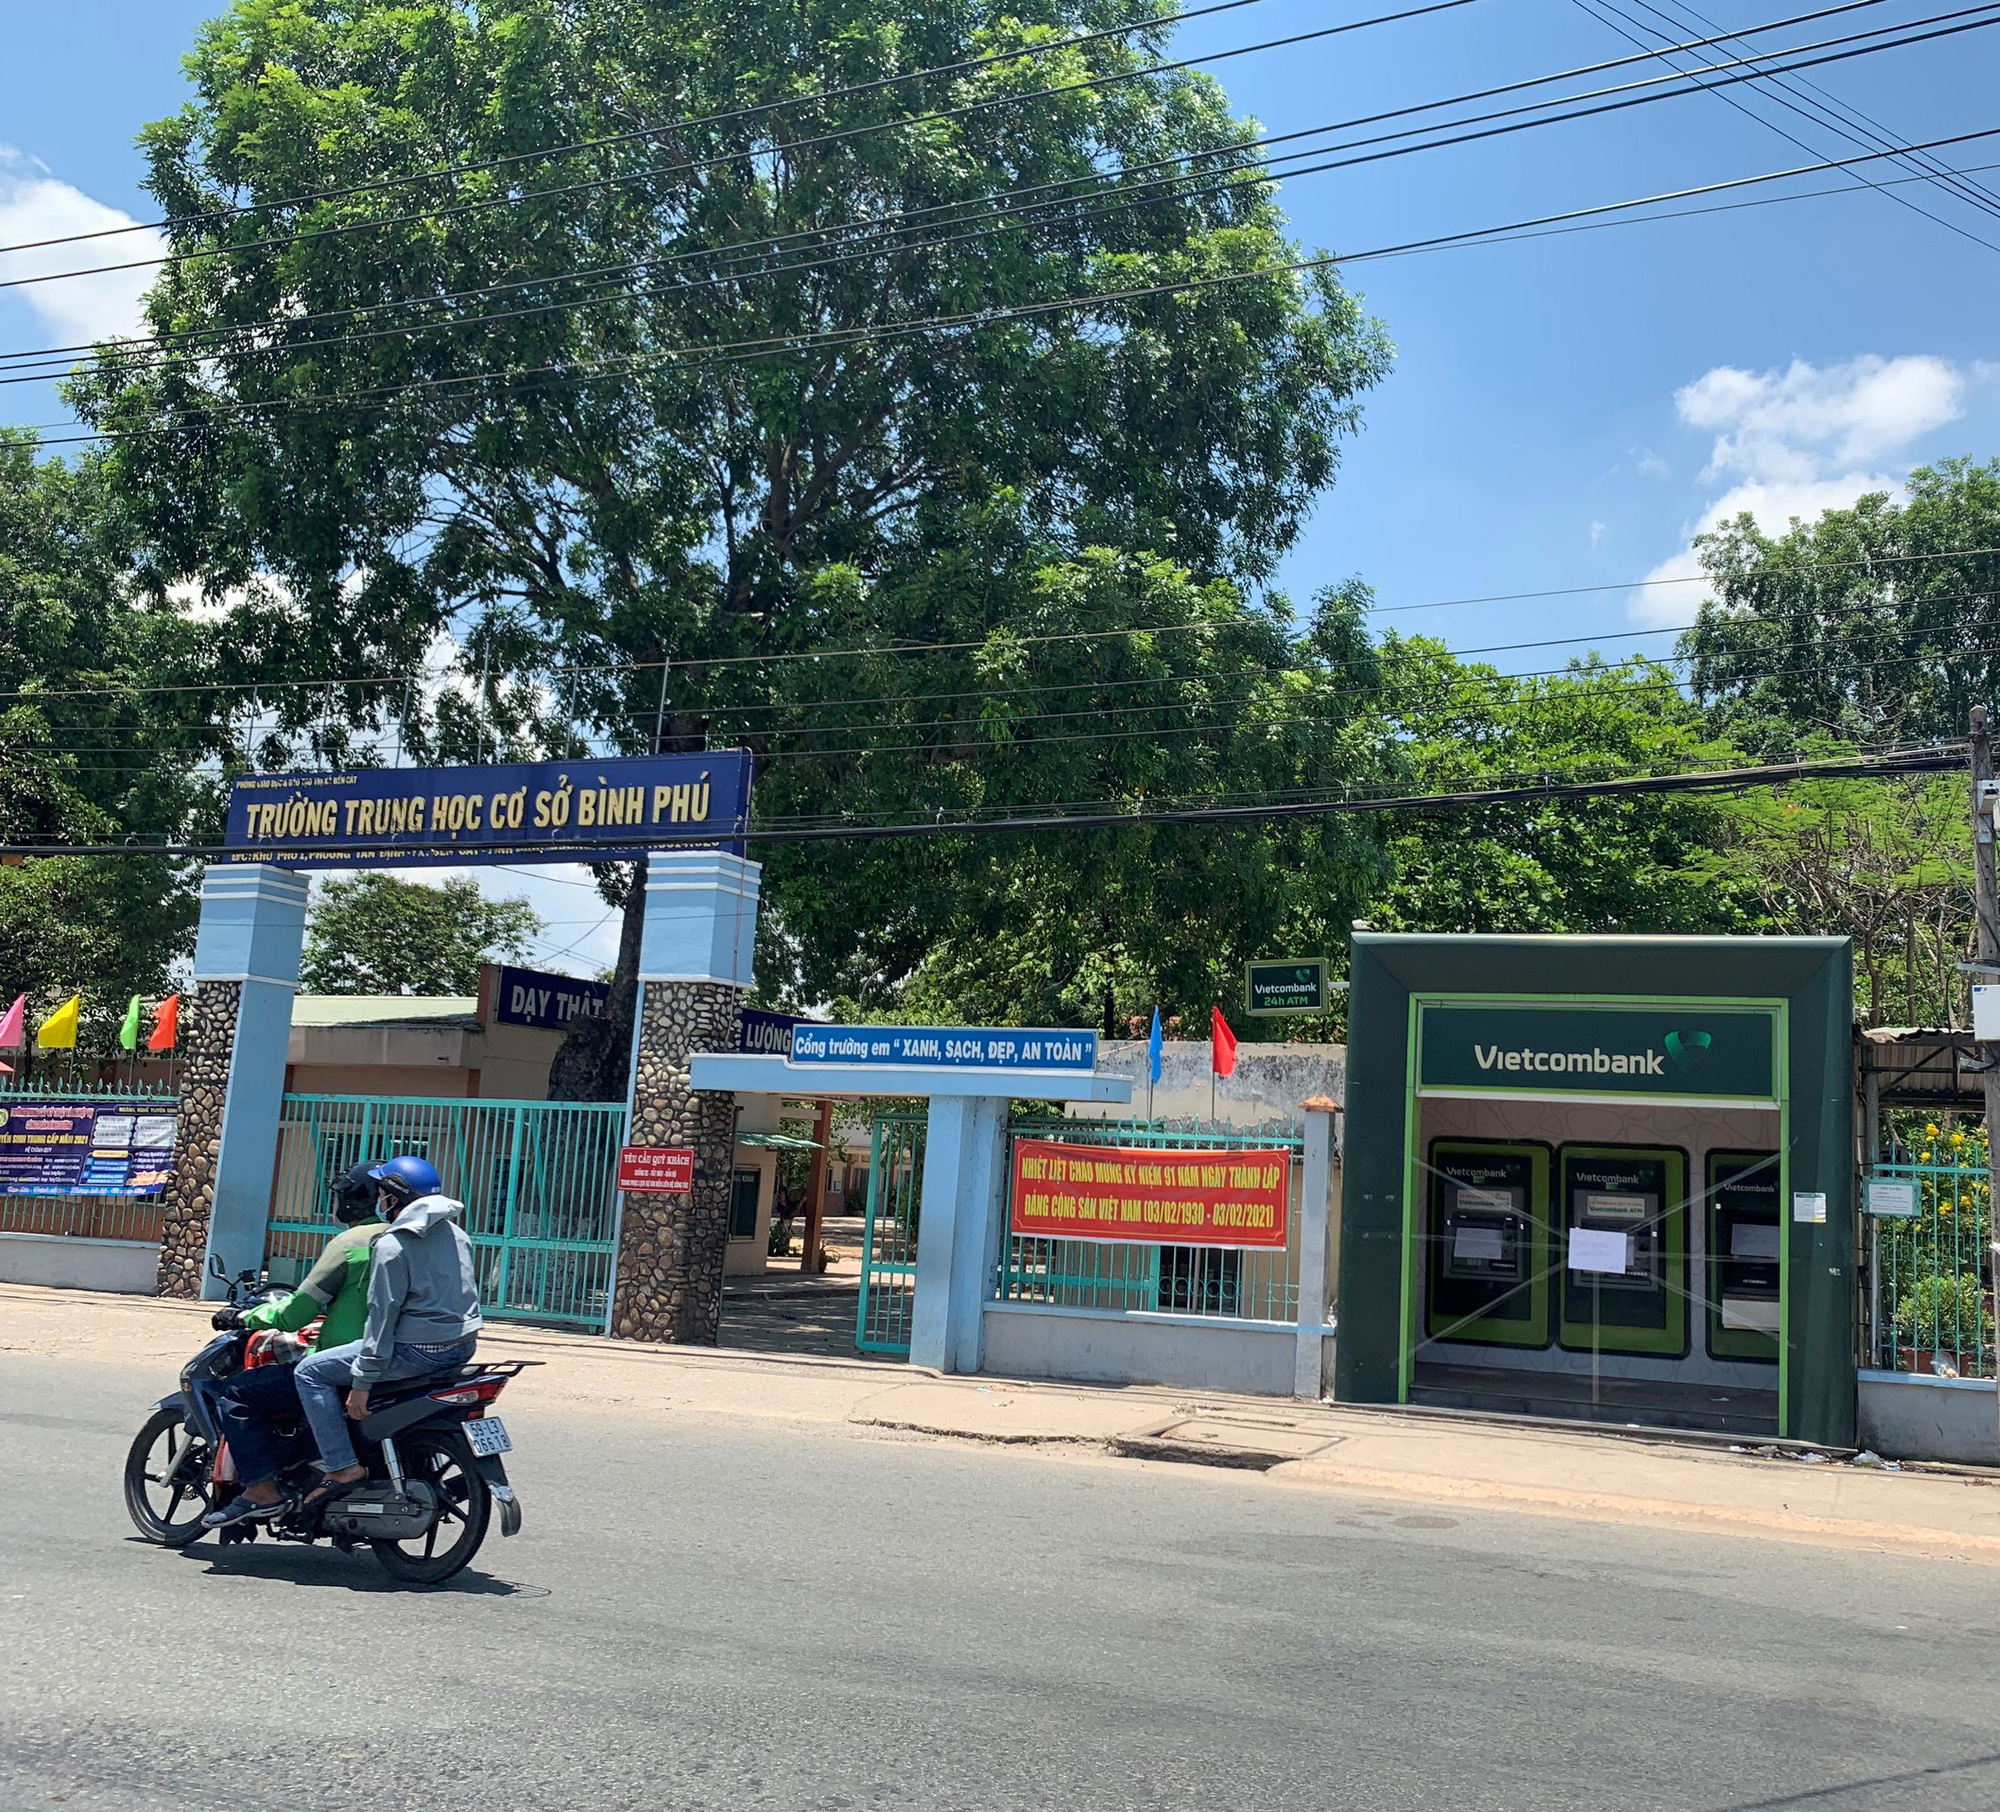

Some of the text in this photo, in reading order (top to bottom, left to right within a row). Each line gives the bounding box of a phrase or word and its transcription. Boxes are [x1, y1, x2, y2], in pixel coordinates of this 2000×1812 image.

[246, 771, 710, 840] TRƯỜNG TRUNG HỌC CƠ SỞ BÌNH PHÚ
[1254, 982, 1317, 994] Vietcombank
[511, 985, 551, 1023] DẠY
[1264, 996, 1308, 1006] 24h ATM
[745, 1021, 792, 1054] LƯỢNG
[795, 1032, 826, 1059] Cổng
[829, 1037, 868, 1059] trường
[871, 1042, 890, 1056] em
[902, 1038, 942, 1060] XANH,
[945, 1039, 985, 1063] SẠCH,
[988, 1041, 1018, 1064] ĐẸP,
[1022, 1042, 1041, 1060] AN
[1045, 1037, 1082, 1061] TOÀN
[1474, 1044, 1665, 1075] Vietcombank
[74, 1135, 88, 1144] 2021
[667, 1154, 690, 1166] KHÁCH
[1021, 1154, 1048, 1184] NHIỆT
[1048, 1156, 1067, 1185] LIỆT
[1069, 1158, 1094, 1183] CHÀO
[1095, 1159, 1122, 1184] MỪNG
[1138, 1162, 1162, 1190] NIỆM
[1164, 1165, 1176, 1186] 91
[1177, 1163, 1199, 1187] NĂM
[1201, 1162, 1227, 1188] NGÀY
[1229, 1162, 1261, 1189] THÀNH
[1262, 1162, 1280, 1194] LẬP
[1446, 1166, 1507, 1178] Vietcombank
[1576, 1172, 1640, 1184] Vietcombank
[1723, 1183, 1775, 1193] Vietcombank
[1024, 1188, 1049, 1217] ĐẢNG
[1051, 1191, 1076, 1222] CỘNG
[1078, 1191, 1097, 1219] SẢN
[1099, 1194, 1119, 1225] VIỆT
[1120, 1199, 1141, 1222] NAM
[1143, 1200, 1205, 1226] (03/02/1930
[1212, 1202, 1274, 1228] 03/02/2021)
[470, 1420, 499, 1437] 59-L3
[473, 1434, 510, 1454] 066.18
